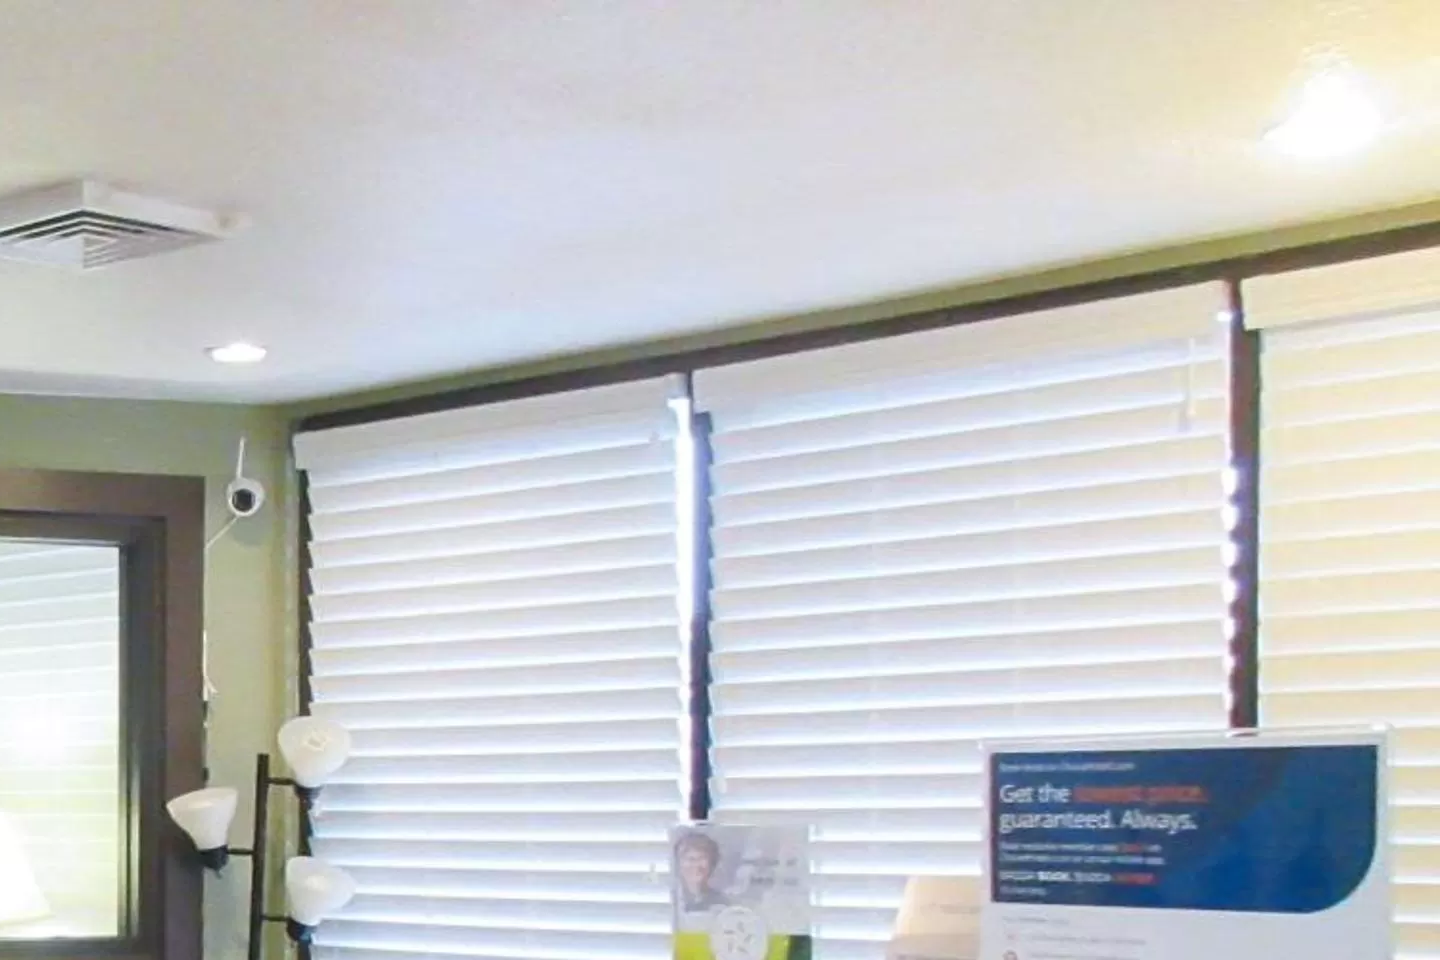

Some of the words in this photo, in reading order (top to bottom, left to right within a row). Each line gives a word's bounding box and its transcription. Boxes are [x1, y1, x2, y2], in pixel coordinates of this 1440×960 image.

[998, 784, 1033, 804] Get
[1038, 781, 1072, 804] the
[998, 809, 1115, 834] guaranteed.
[1119, 808, 1198, 835] Always.
